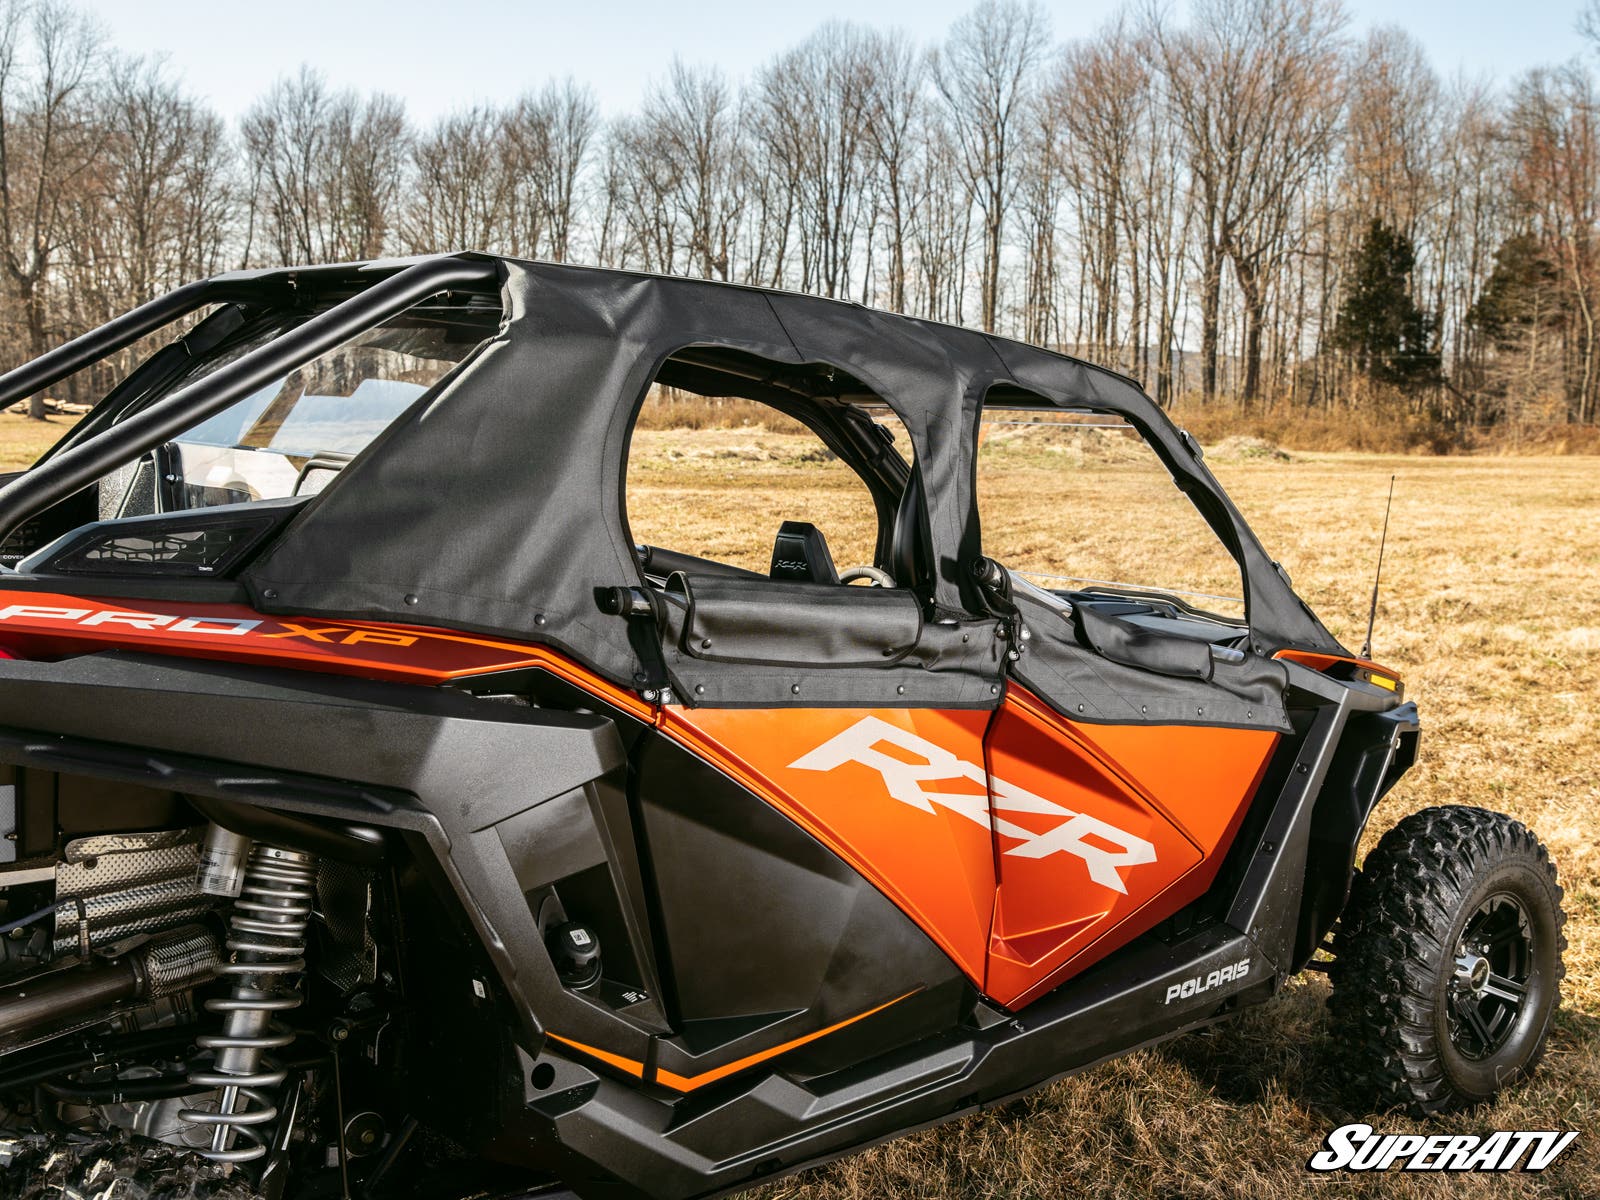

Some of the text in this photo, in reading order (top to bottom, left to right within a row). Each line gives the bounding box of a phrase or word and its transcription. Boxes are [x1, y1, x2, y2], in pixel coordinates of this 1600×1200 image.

[0, 604, 420, 647] PRO XP
[785, 715, 1158, 896] RZR
[1165, 958, 1250, 1005] POLARIS
